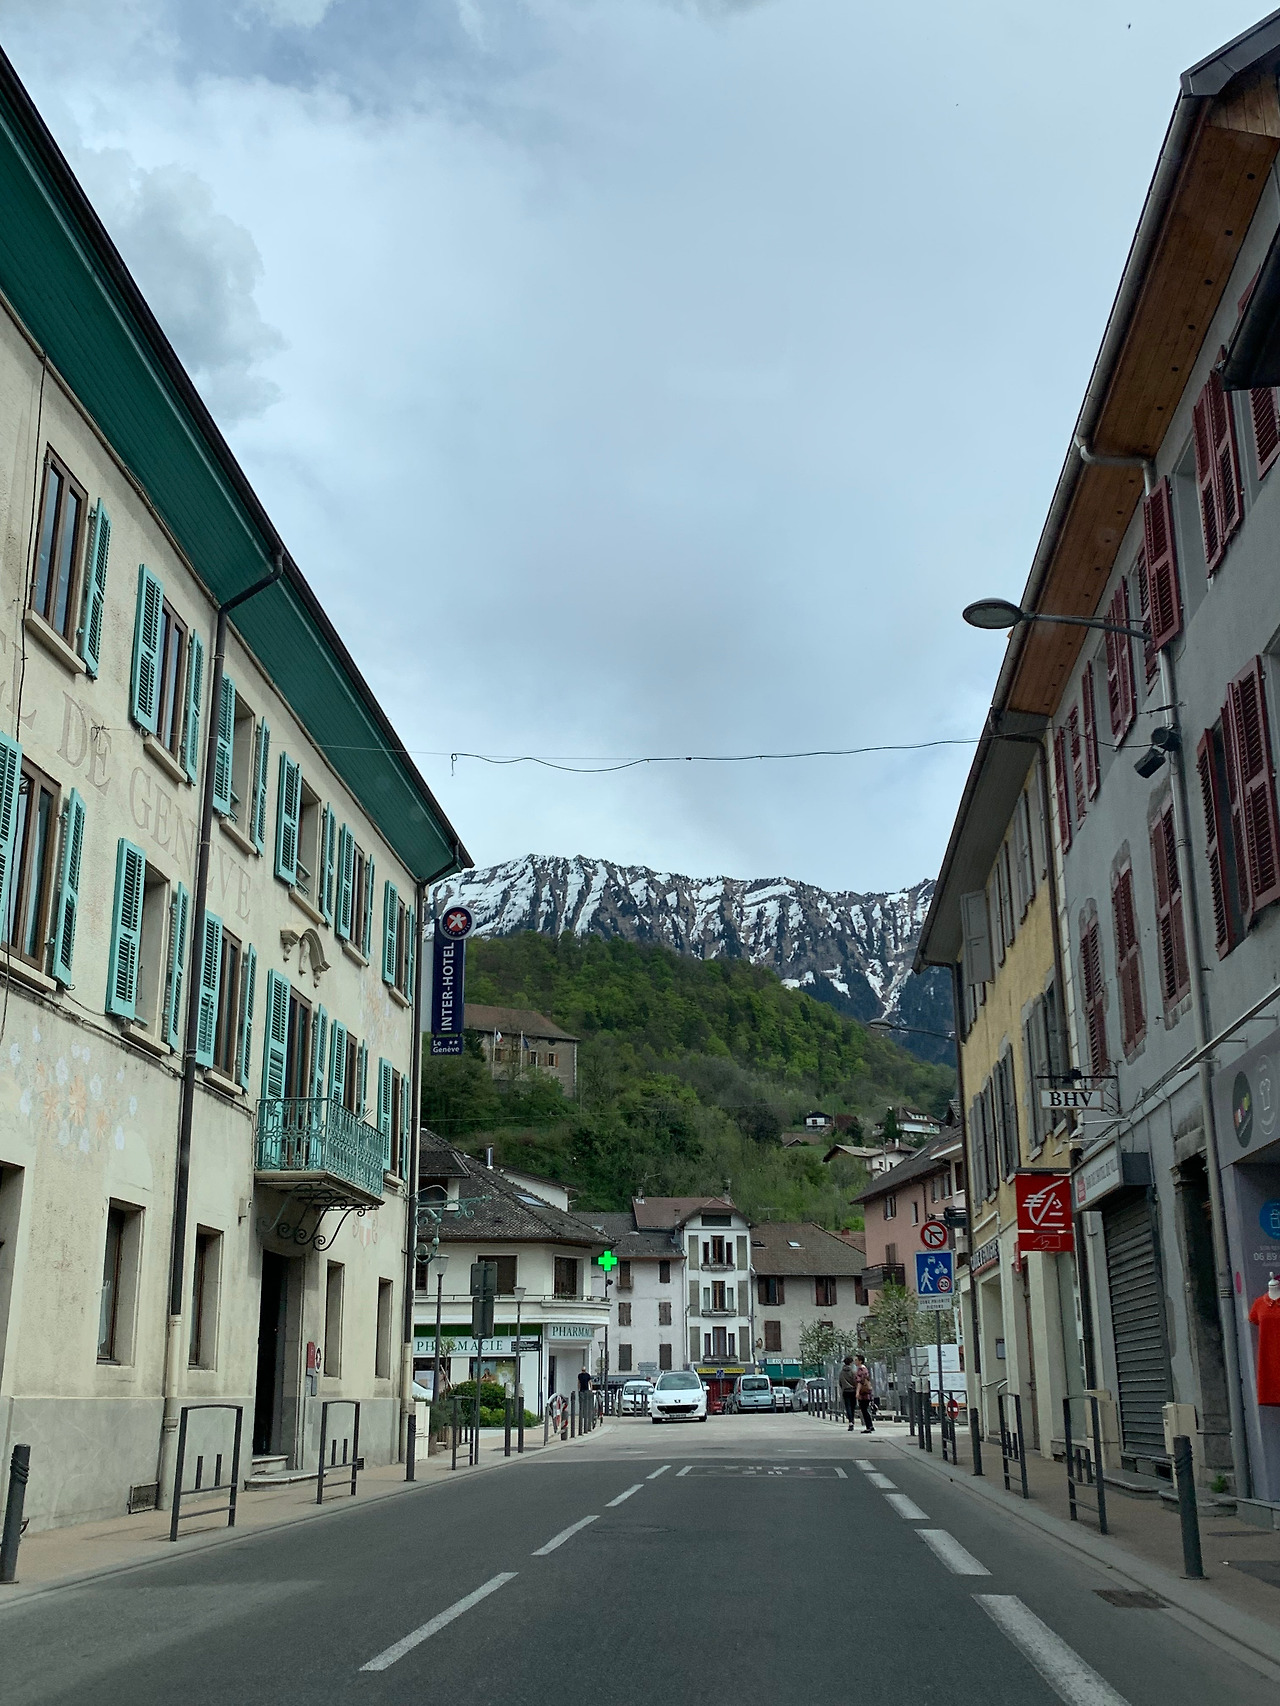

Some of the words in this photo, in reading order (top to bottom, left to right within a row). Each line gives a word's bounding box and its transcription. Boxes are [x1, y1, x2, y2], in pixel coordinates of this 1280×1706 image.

[57, 690, 112, 796] DE
[441, 942, 455, 1031] INTER-HOTEL
[1049, 1091, 1093, 1107] BHV
[416, 1340, 503, 1351] PHMACIE
